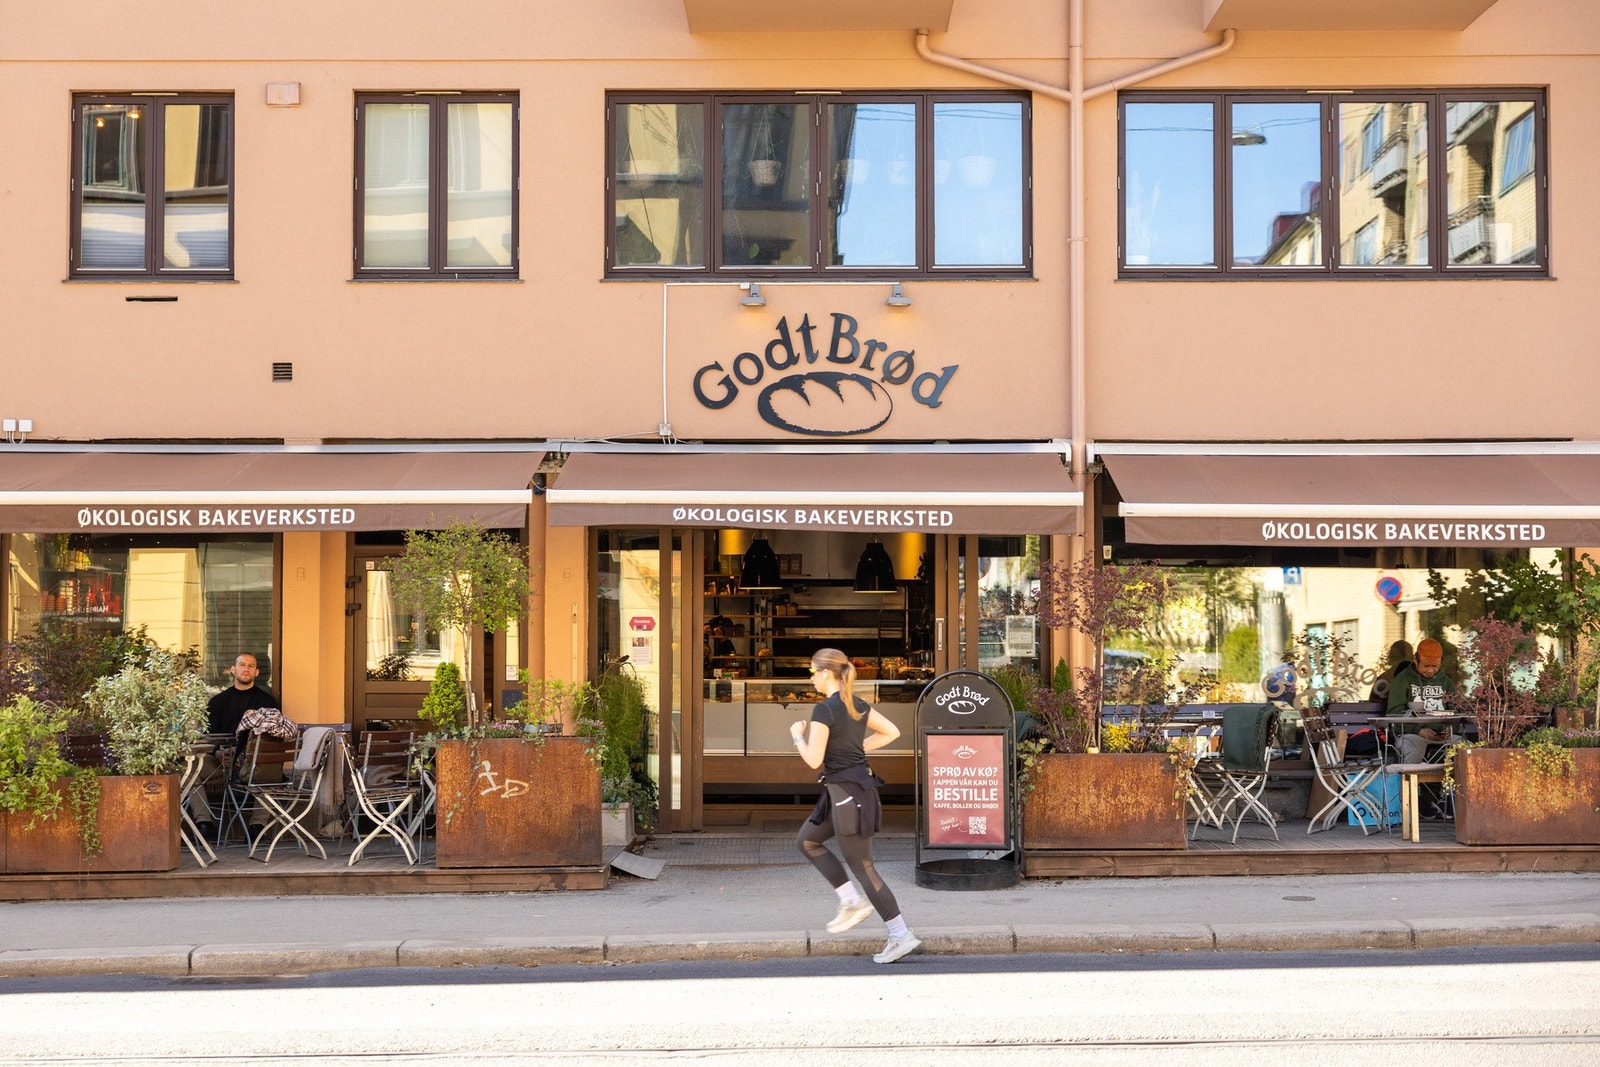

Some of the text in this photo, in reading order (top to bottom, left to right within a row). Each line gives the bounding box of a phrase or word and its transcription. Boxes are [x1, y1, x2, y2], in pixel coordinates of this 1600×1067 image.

[693, 312, 959, 410] Godt Brød
[77, 508, 356, 527] ØKOLOGISK BAKEVERKSTED
[672, 506, 954, 527] ØKOLOGISK BAKEVERKSTED
[1262, 520, 1546, 541] ØKOLOGISK BAKEVERKSTED
[936, 686, 990, 706] Godt Brød
[933, 766, 998, 777] SPRØ AV KØ?
[934, 788, 998, 800] BESTILLE
